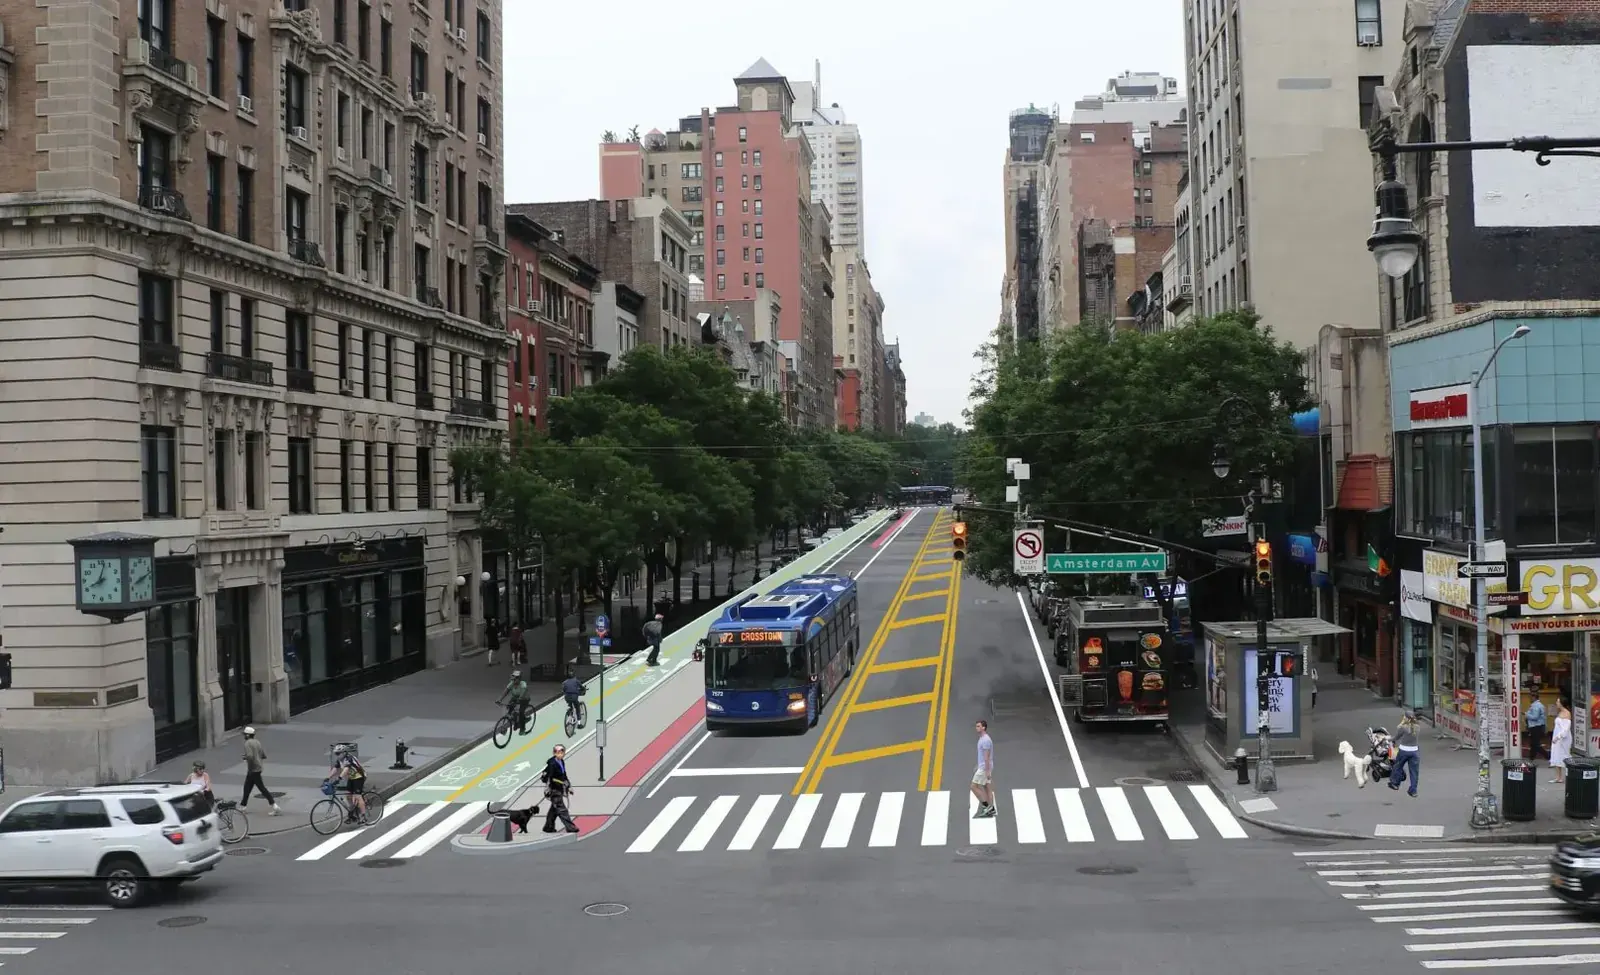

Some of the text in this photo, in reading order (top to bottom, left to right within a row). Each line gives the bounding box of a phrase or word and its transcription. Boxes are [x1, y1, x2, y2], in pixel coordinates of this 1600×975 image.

[1053, 557, 1160, 569] Amsterdam Av
[1523, 565, 1600, 610] GR
[1511, 622, 1539, 630] WHEN
[1542, 620, 1575, 629] YOU'RE
[741, 632, 782, 641] CROSSTOWN
[1509, 648, 1518, 747] WELCOME
